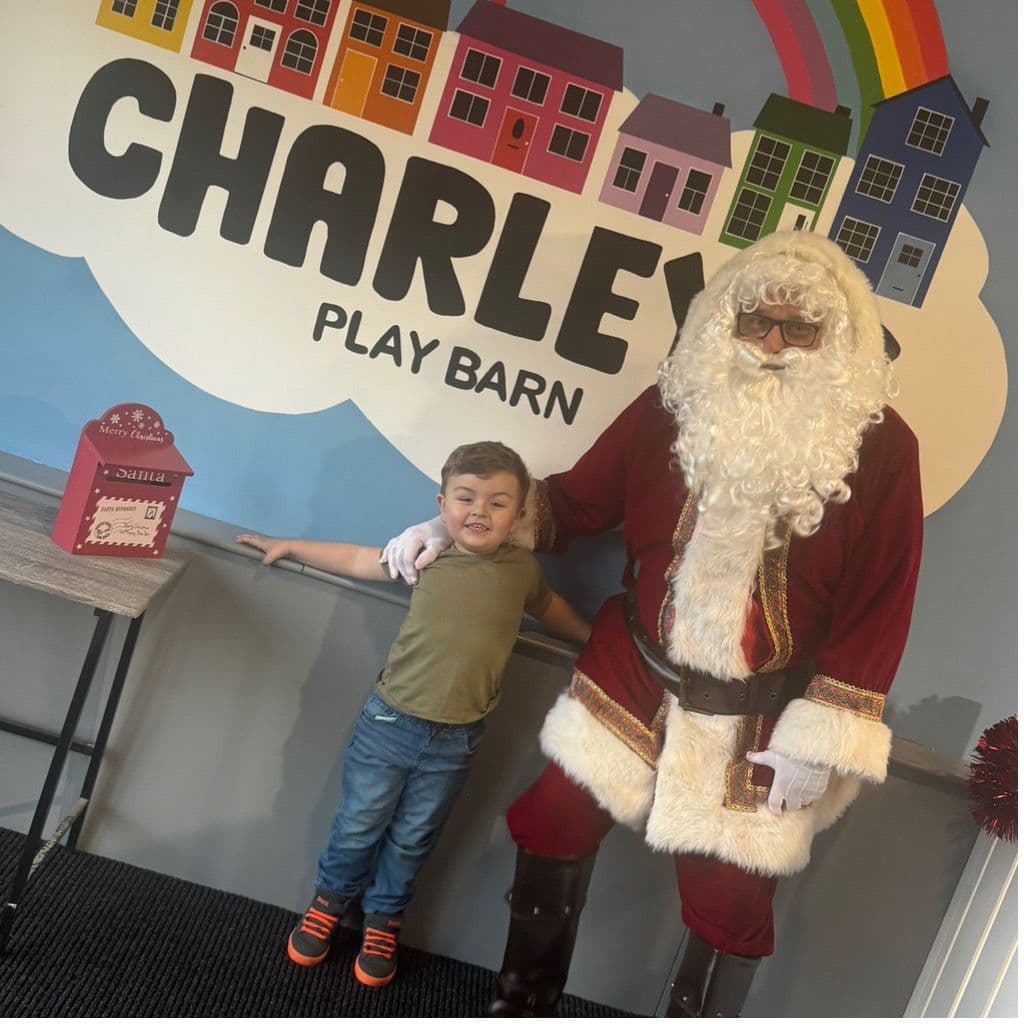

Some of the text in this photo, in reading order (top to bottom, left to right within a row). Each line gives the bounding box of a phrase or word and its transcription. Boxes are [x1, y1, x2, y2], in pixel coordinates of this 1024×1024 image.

[312, 302, 584, 426] PLAY BARN
[99, 425, 127, 437] Merry
